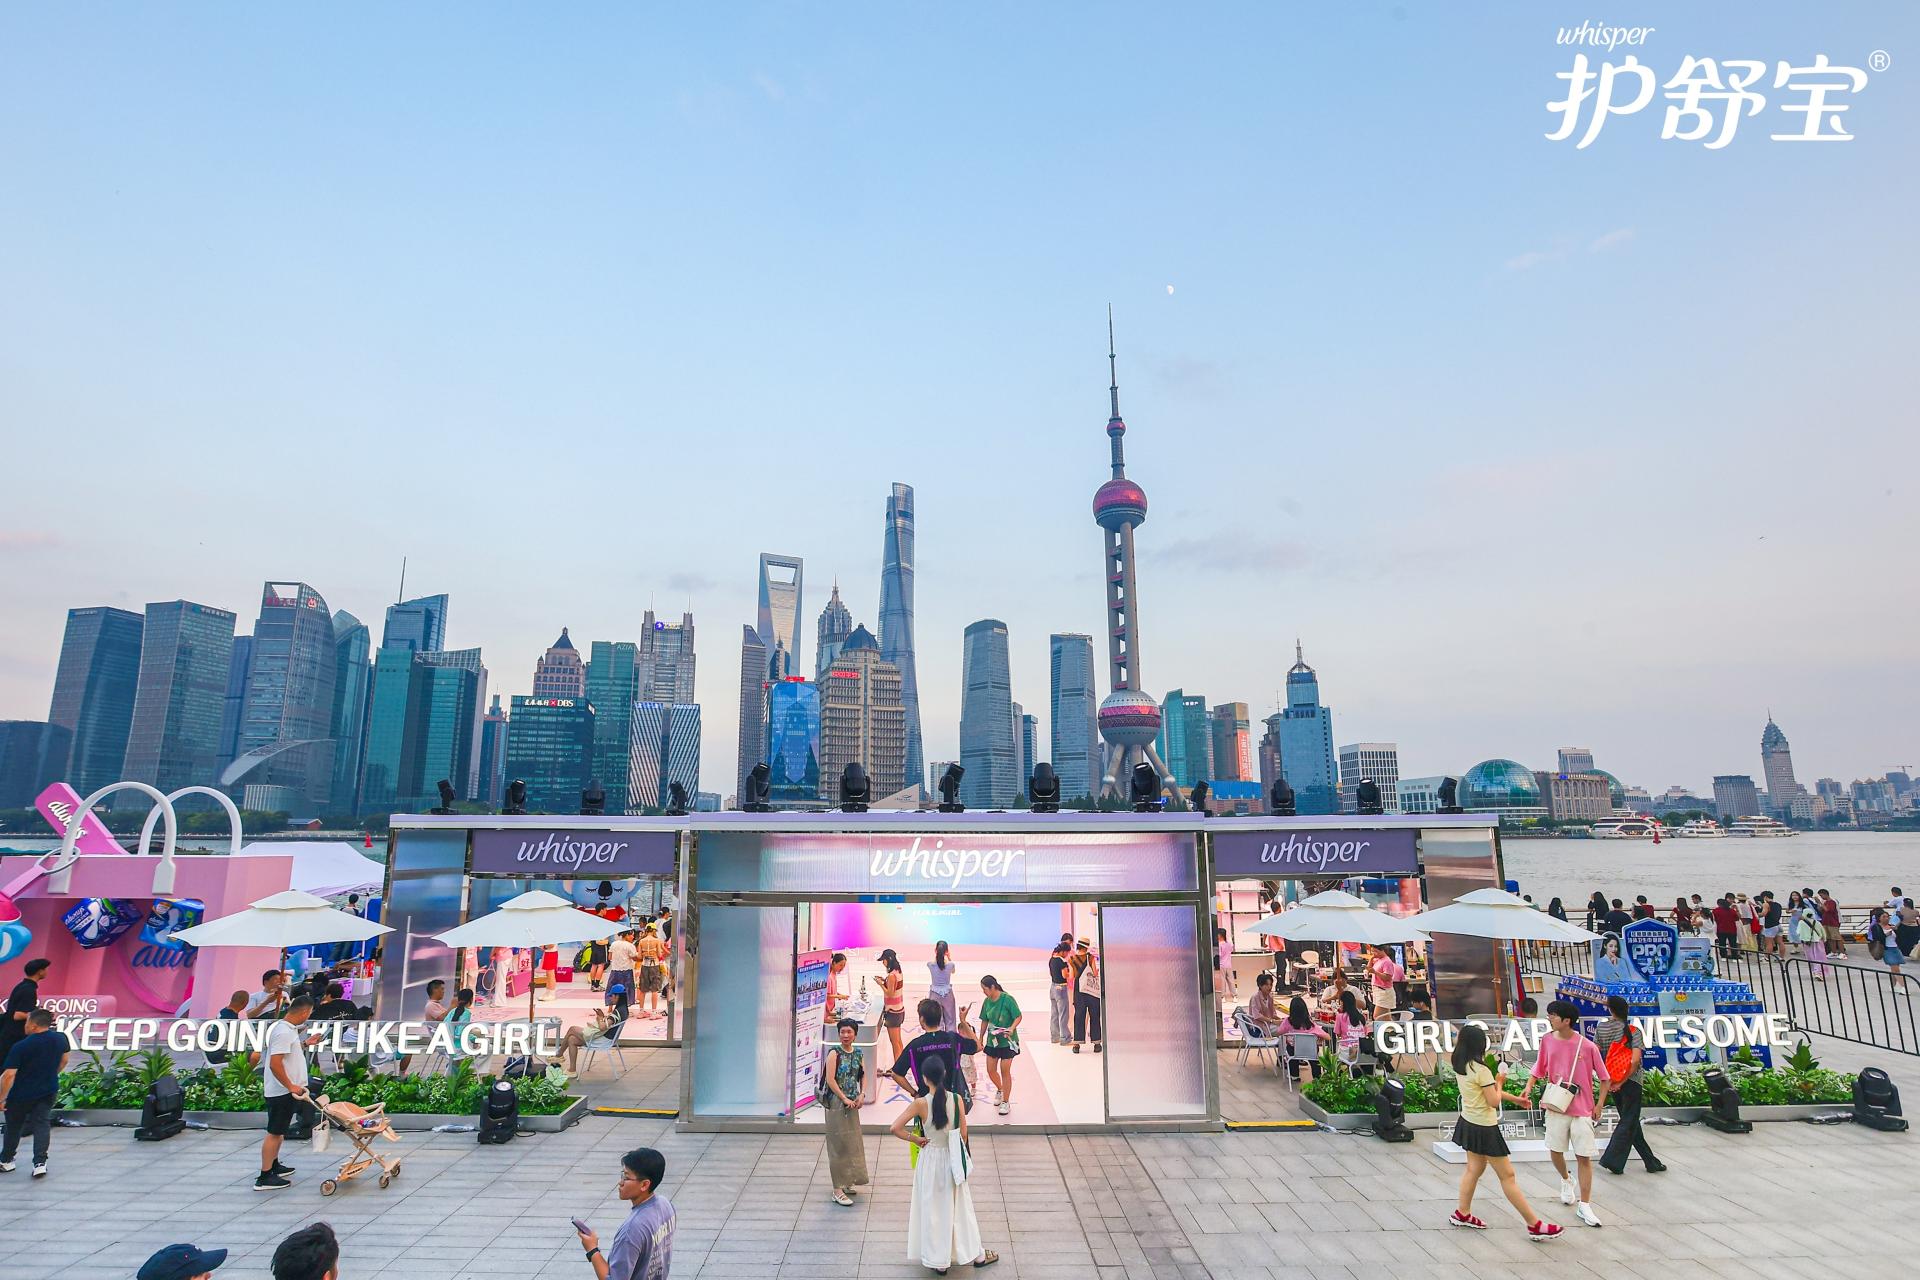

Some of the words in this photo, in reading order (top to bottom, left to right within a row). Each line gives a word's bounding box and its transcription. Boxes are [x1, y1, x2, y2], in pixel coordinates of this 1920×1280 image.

[557, 699, 574, 708] DBS
[517, 832, 628, 871] whisper
[870, 837, 1025, 889] whisper
[1260, 833, 1370, 871] whisper
[1632, 943, 1671, 960] PRO
[43, 998, 98, 1013] GOING
[57, 1018, 158, 1051] KEEP
